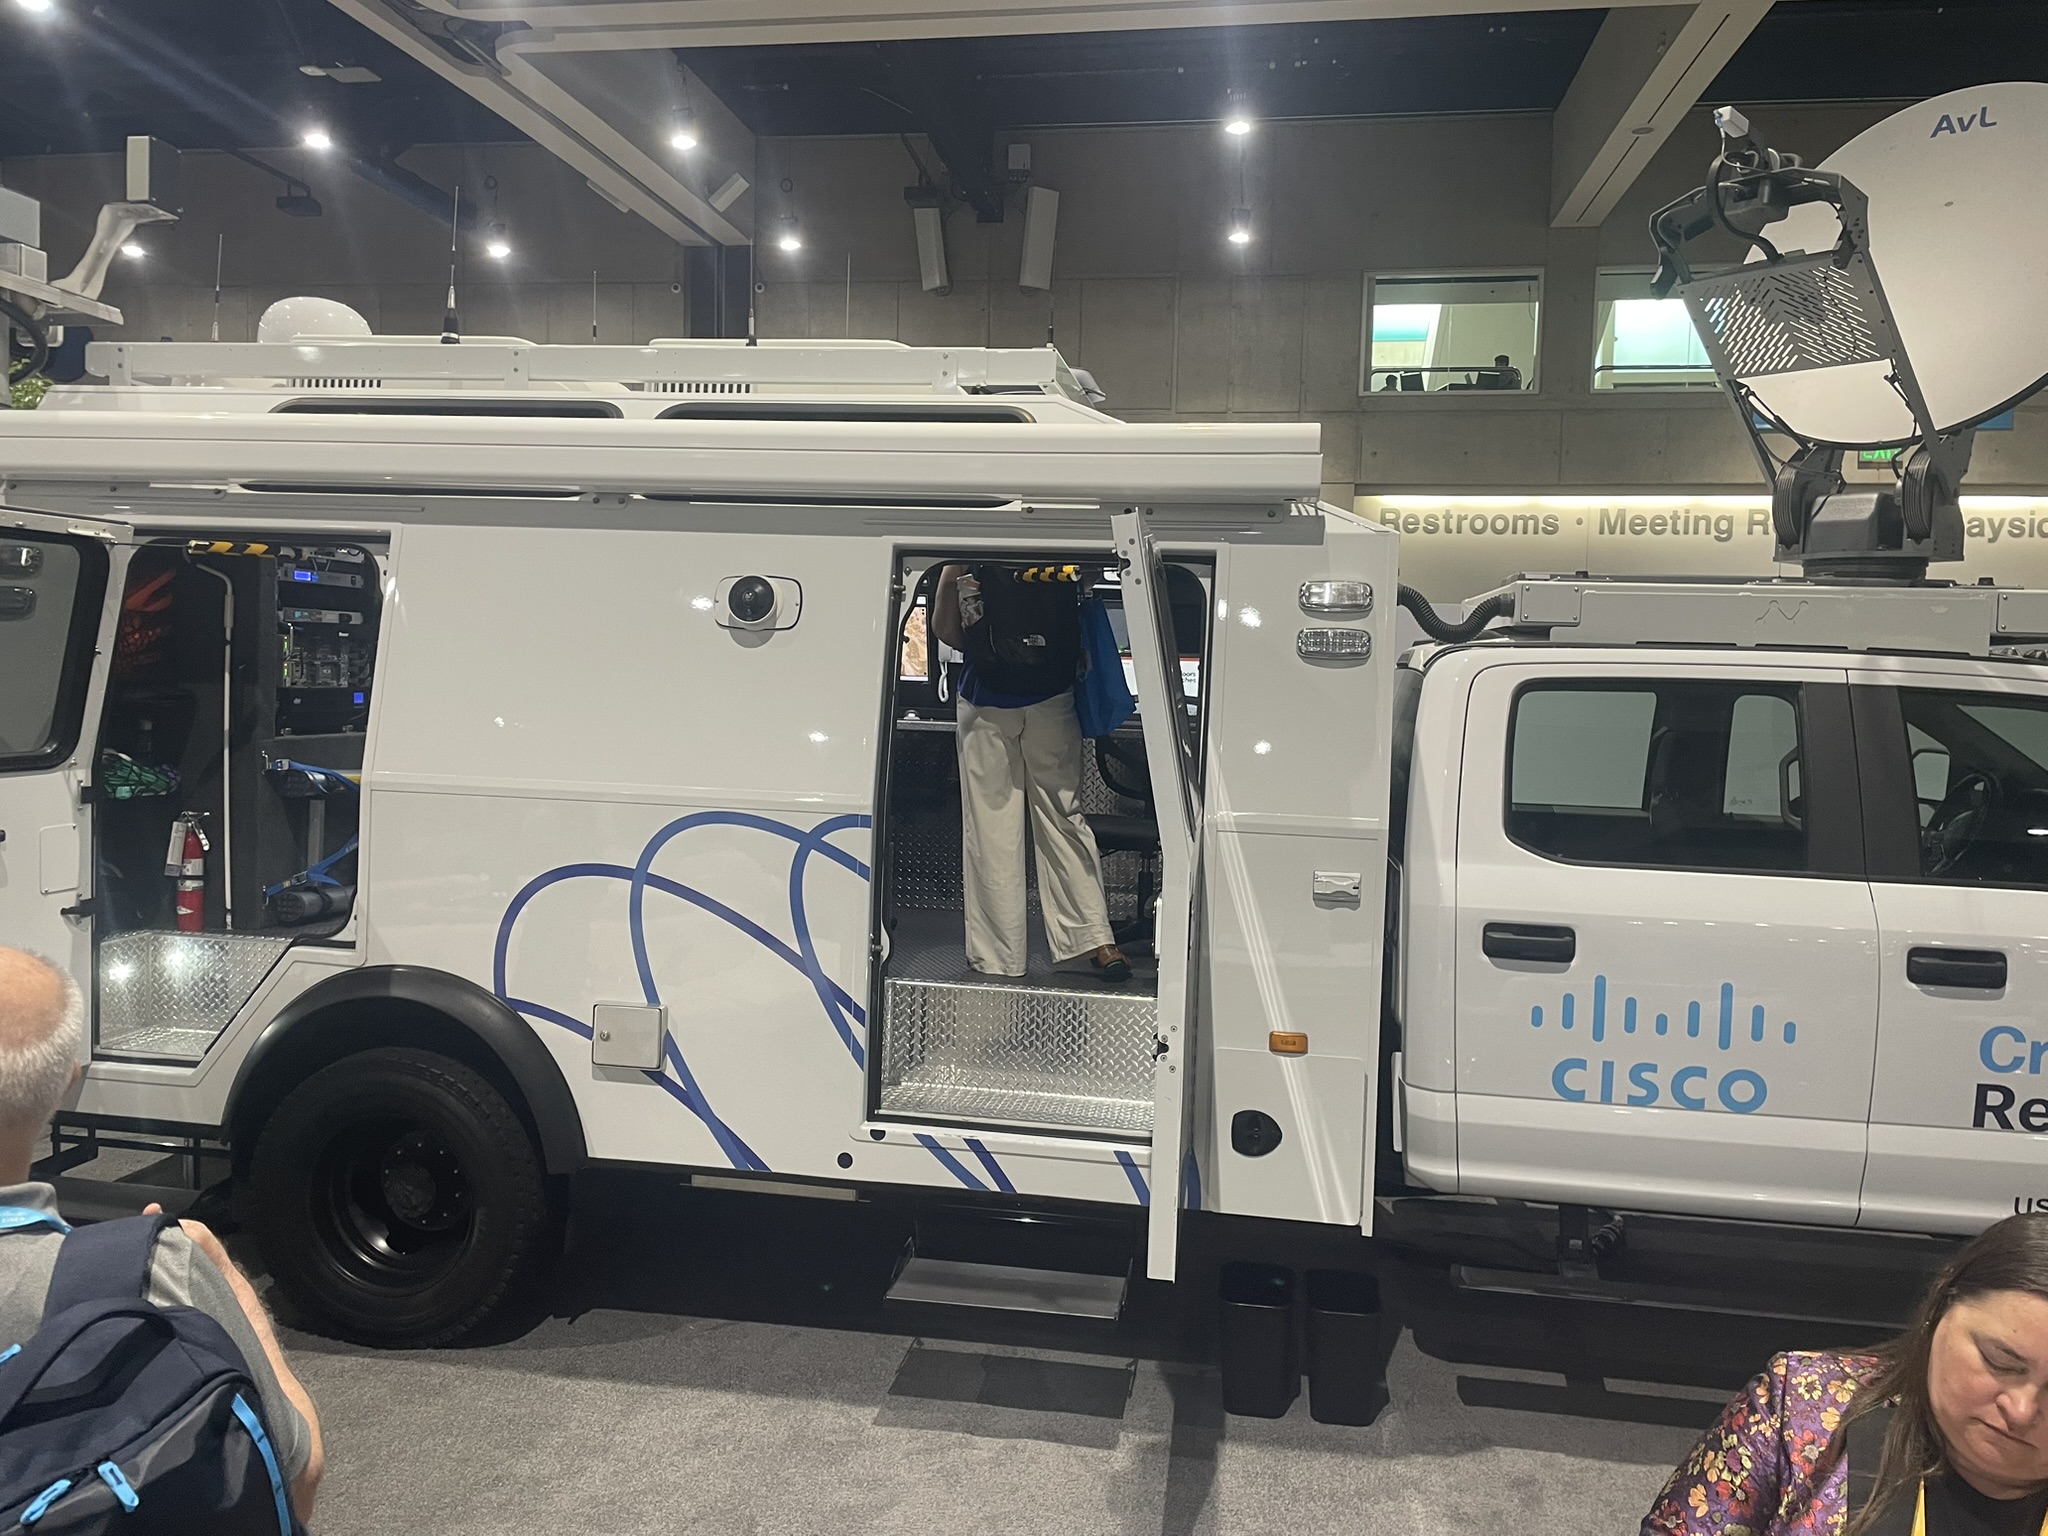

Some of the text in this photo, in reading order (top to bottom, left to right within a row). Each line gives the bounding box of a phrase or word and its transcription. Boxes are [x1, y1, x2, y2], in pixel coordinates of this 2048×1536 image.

[1380, 508, 1560, 536] Restrooms
[1598, 508, 1735, 543] Meeting
[1747, 508, 1774, 536] R
[1551, 1057, 1768, 1114] CISCO
[1972, 1083, 2048, 1133] Re
